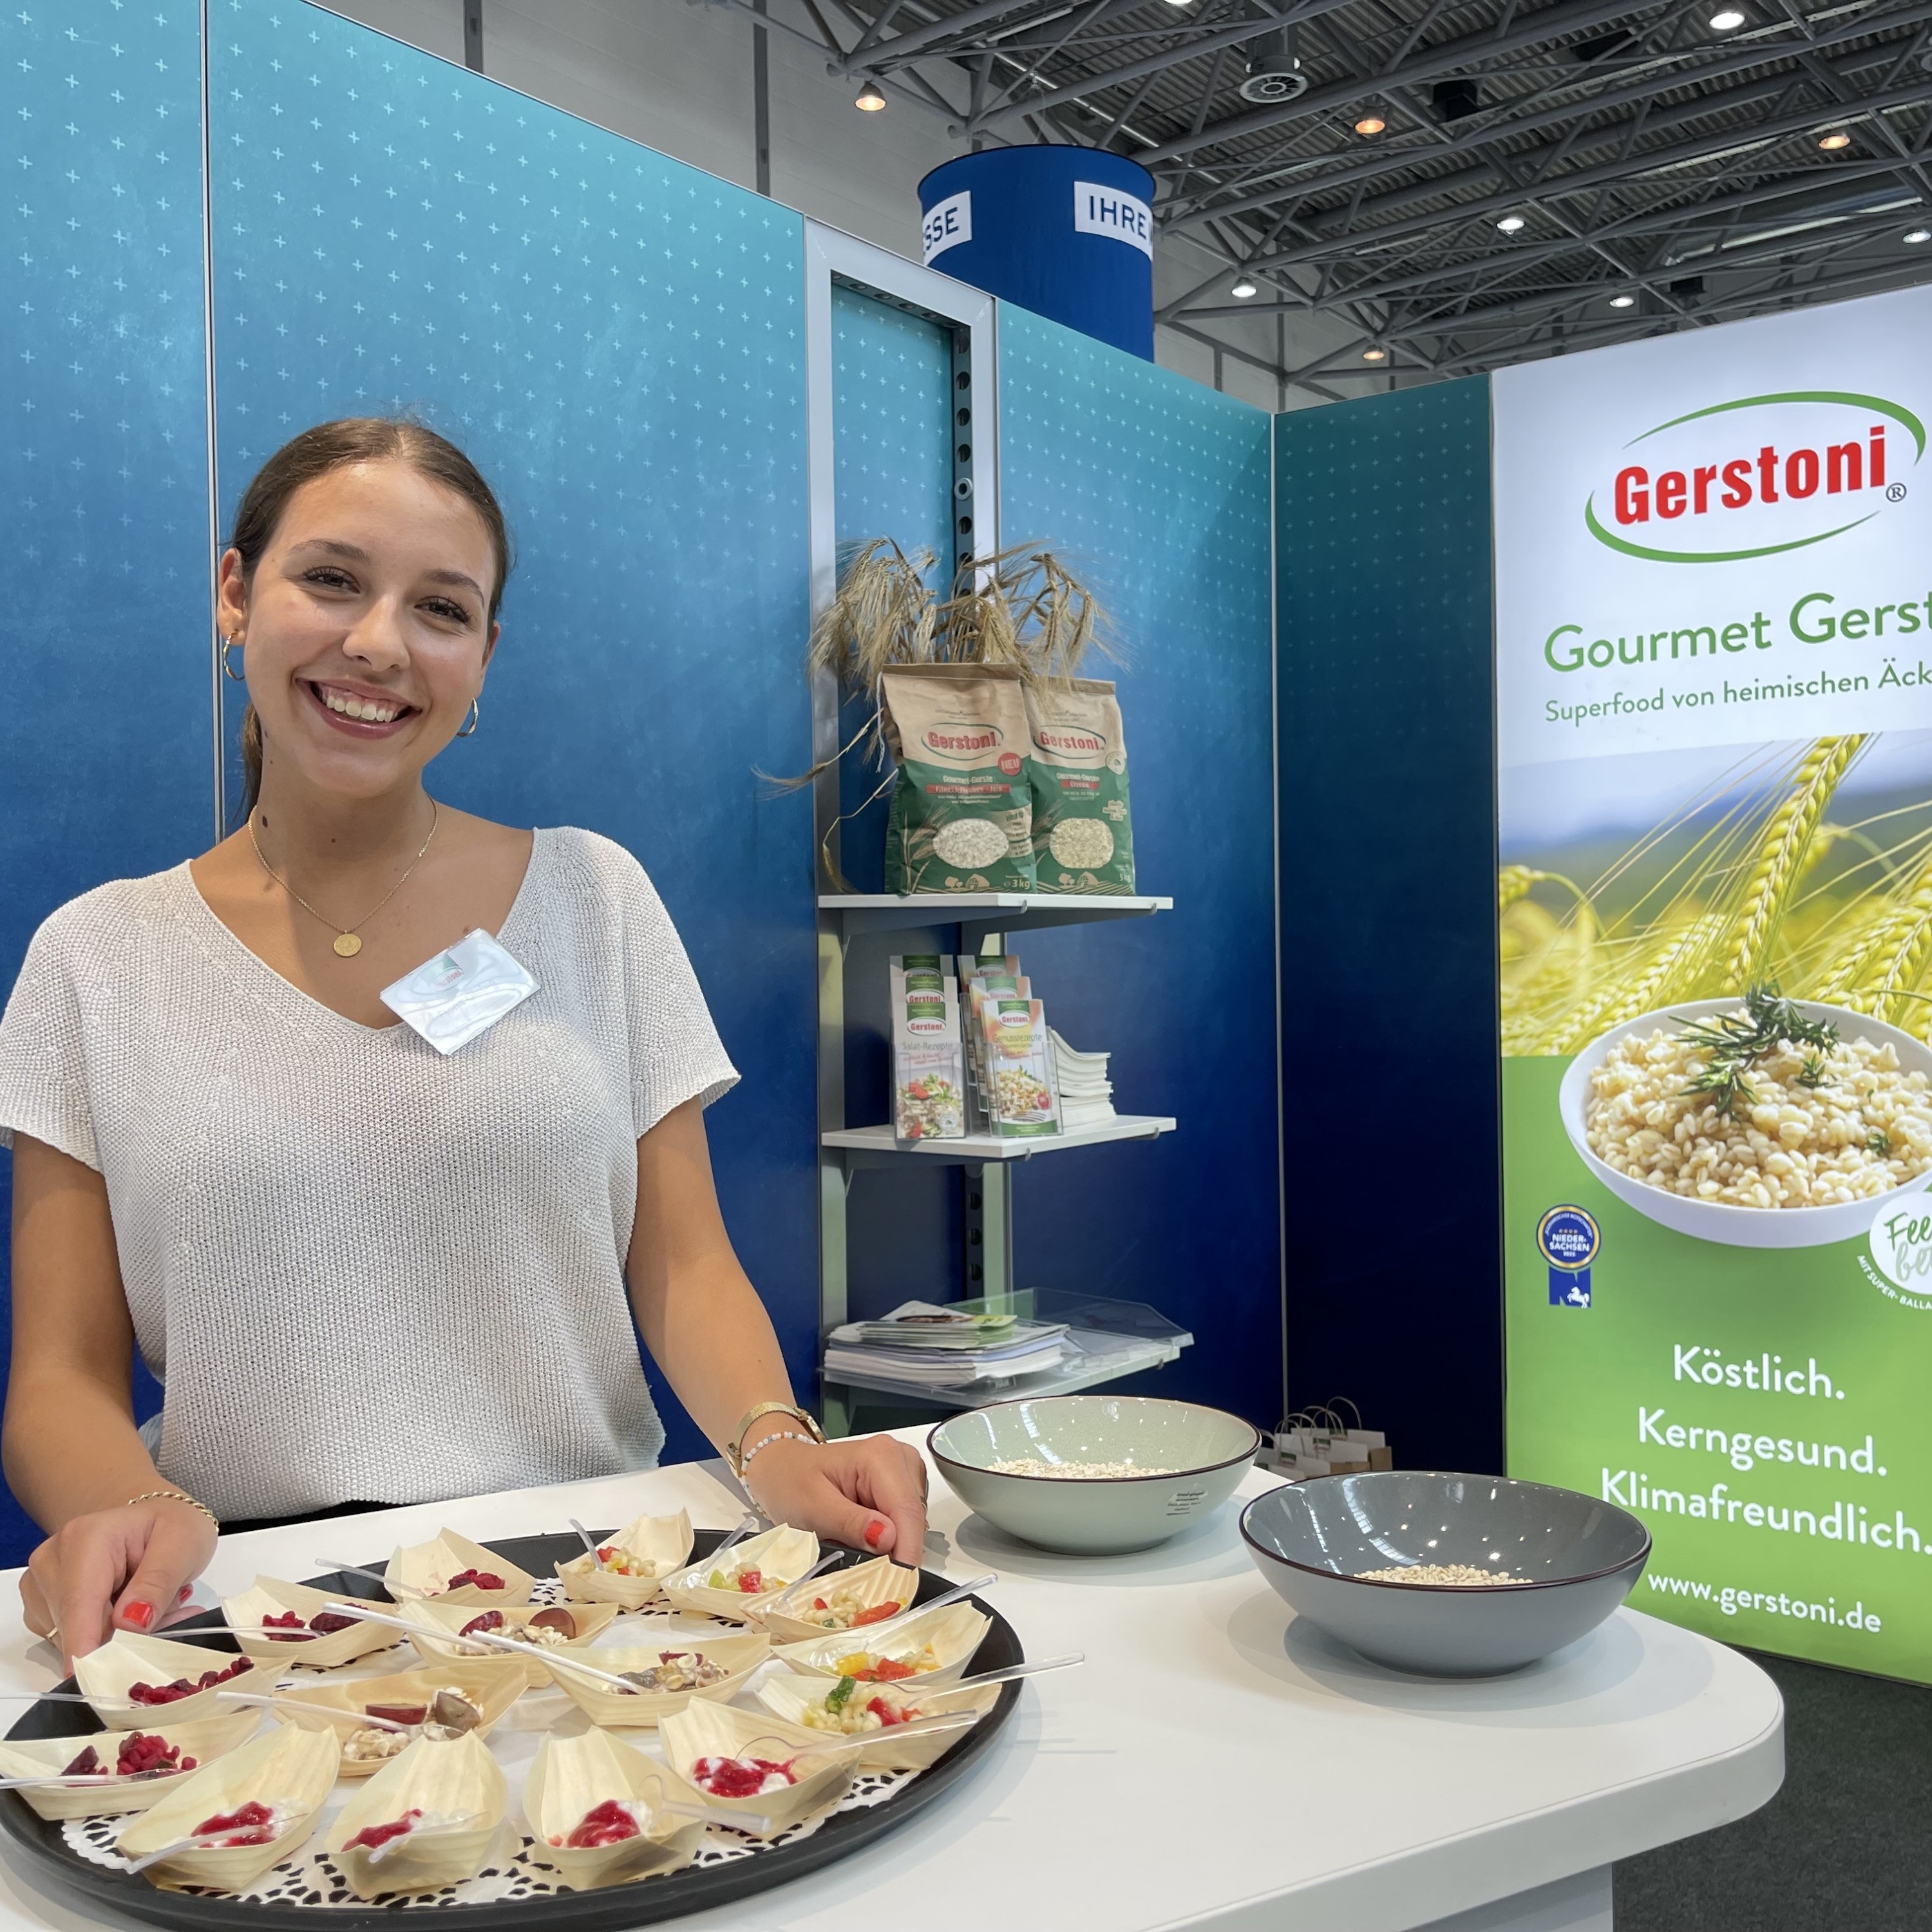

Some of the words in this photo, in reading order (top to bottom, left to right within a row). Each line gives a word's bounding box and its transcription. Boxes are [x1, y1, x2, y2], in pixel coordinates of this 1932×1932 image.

[1090, 196, 1146, 240] IHRE
[923, 207, 959, 252] SSE
[1544, 611, 1772, 672] Gourmet
[1545, 687, 1664, 728] Superfood
[1671, 691, 1714, 708] von
[1723, 670, 1869, 704] heimischen
[1877, 657, 1932, 689] Äck
[928, 732, 996, 750] Gerstoni
[1039, 732, 1099, 750] Gerstoni
[1001, 759, 1019, 770] NEU
[1019, 878, 1030, 889] kg
[911, 1023, 943, 1031] Gerstoni
[992, 1034, 1043, 1043] Genussrezepte
[1549, 1241, 1590, 1252] SACHSEN
[1552, 1233, 1587, 1243] NIEDER-
[1857, 1255, 1872, 1273] MIT
[1674, 1344, 1845, 1399] Köstlich.
[1639, 1406, 1887, 1476] Kerngesund.
[1602, 1468, 1932, 1554] Klimafreundlich.
[1648, 1574, 1881, 1632] www.gerstoni.de
